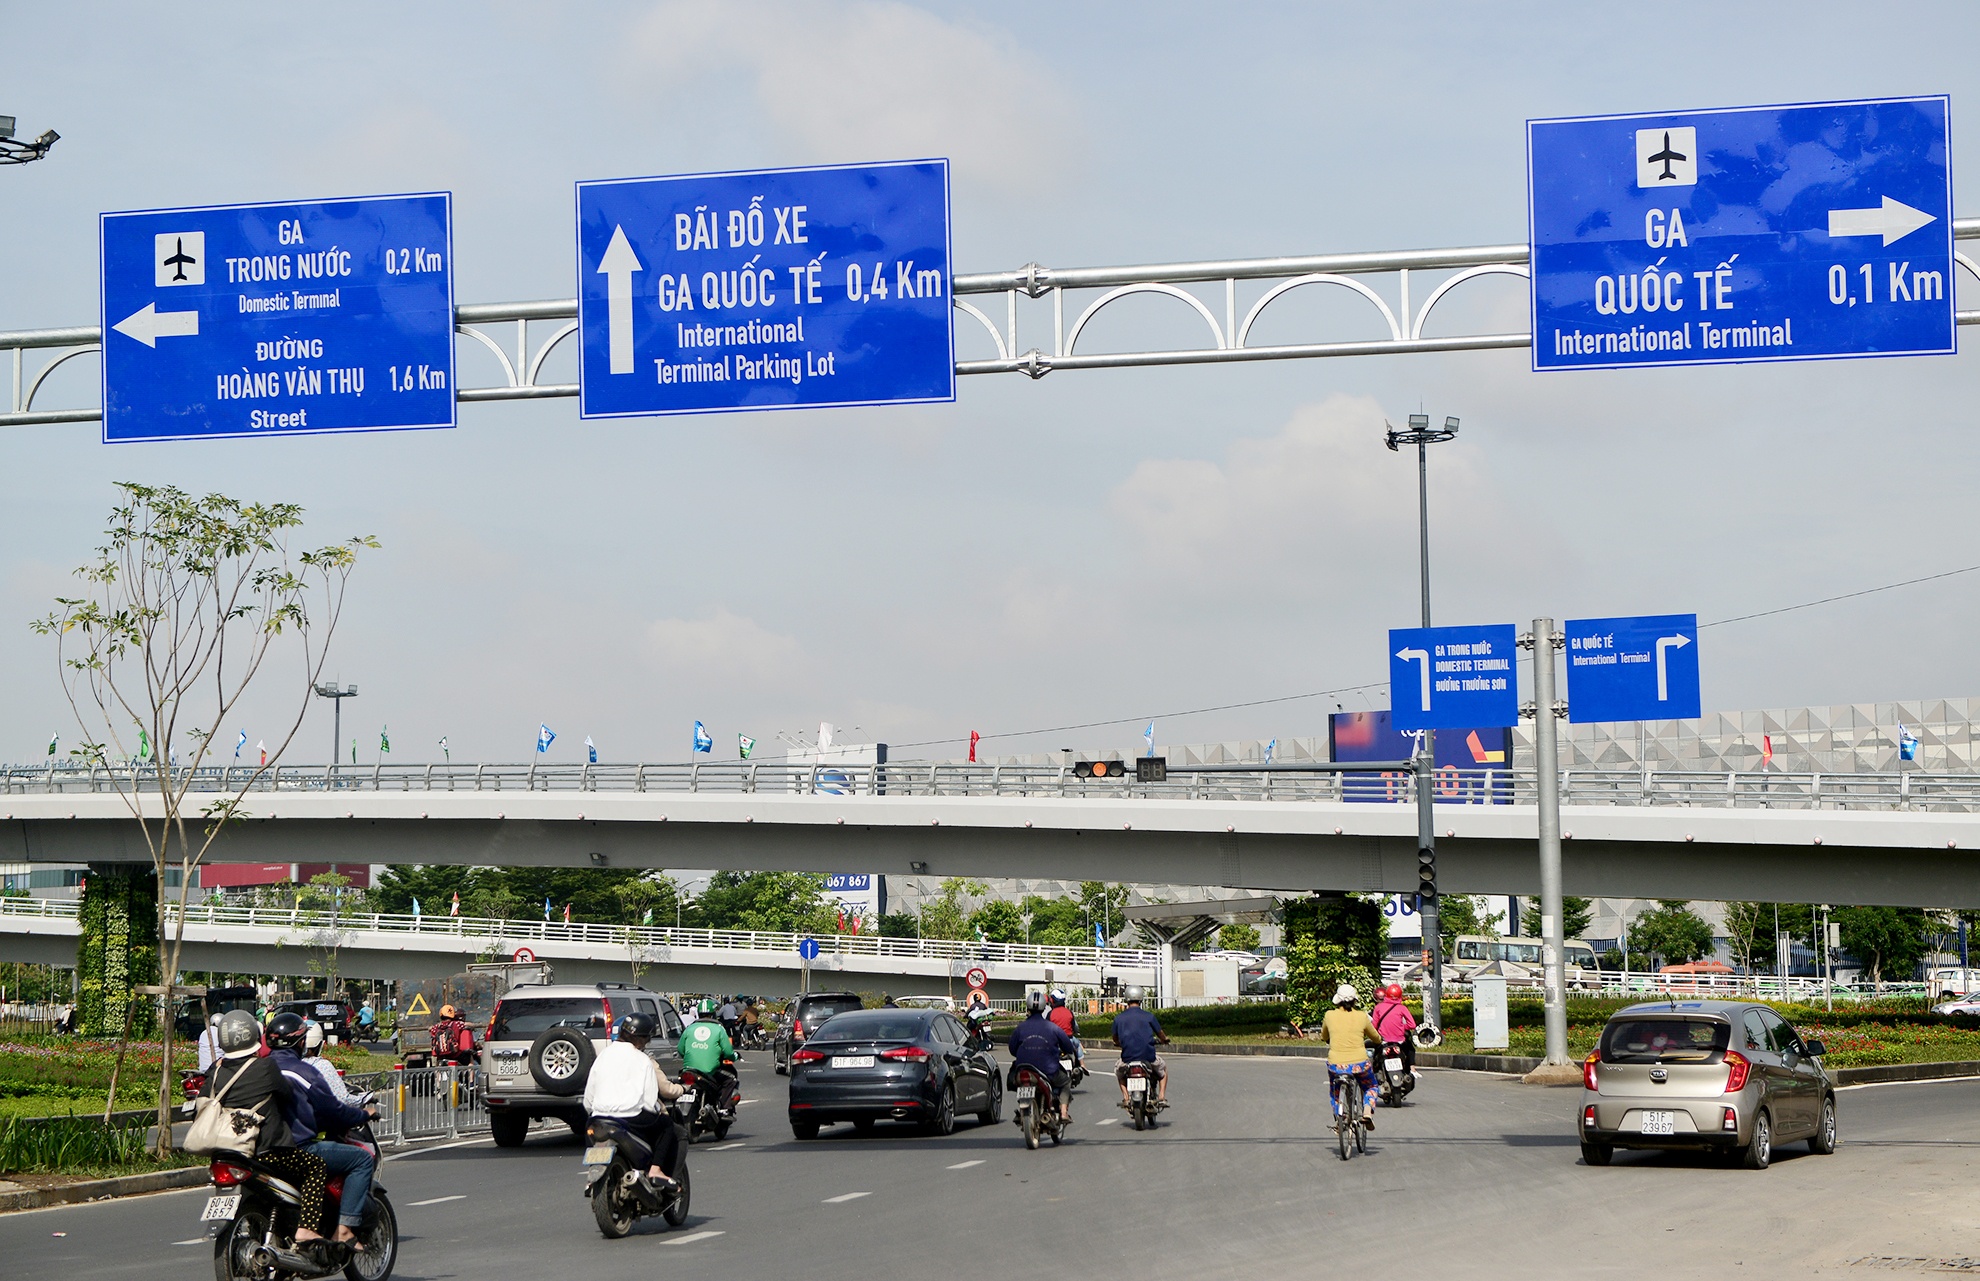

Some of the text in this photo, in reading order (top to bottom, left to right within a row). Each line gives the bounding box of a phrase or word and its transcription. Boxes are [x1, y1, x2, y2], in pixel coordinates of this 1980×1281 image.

[279, 220, 304, 245] GA
[676, 195, 808, 250] BÃI ĐỖ XE
[1646, 208, 1687, 248] GA
[226, 246, 441, 282] TRONG NƯỚC 0,2 Km
[659, 252, 941, 311] GA QUỐC TẾ 0,4 Km
[1595, 254, 1942, 314] QUỐC TẾ 0,1 Km
[240, 289, 340, 313] Domestic Terminal
[678, 316, 804, 348] International
[1556, 319, 1792, 355] International Terminal
[256, 336, 322, 361] ĐƯỜNG
[654, 351, 834, 384] Terminal Parking Lot
[218, 365, 445, 399] HOÀNG VĂN THỤ 1,6 Km
[251, 409, 306, 428] Street
[1436, 640, 1491, 656] GA TRONG NƯỚC
[1572, 633, 1613, 650] GA QUỐC TẾ
[1436, 659, 1509, 672] DOMESTIC TERMINAL
[1574, 652, 1650, 665] International Terminal
[1492, 678, 1506, 690] SƠN
[827, 876, 845, 887] 067
[849, 875, 867, 887] 867
[691, 1041, 709, 1050] Grab
[500, 1065, 519, 1074] 5082
[1642, 1121, 1673, 1133] 239.67
[1649, 1111, 1666, 1123] 51F
